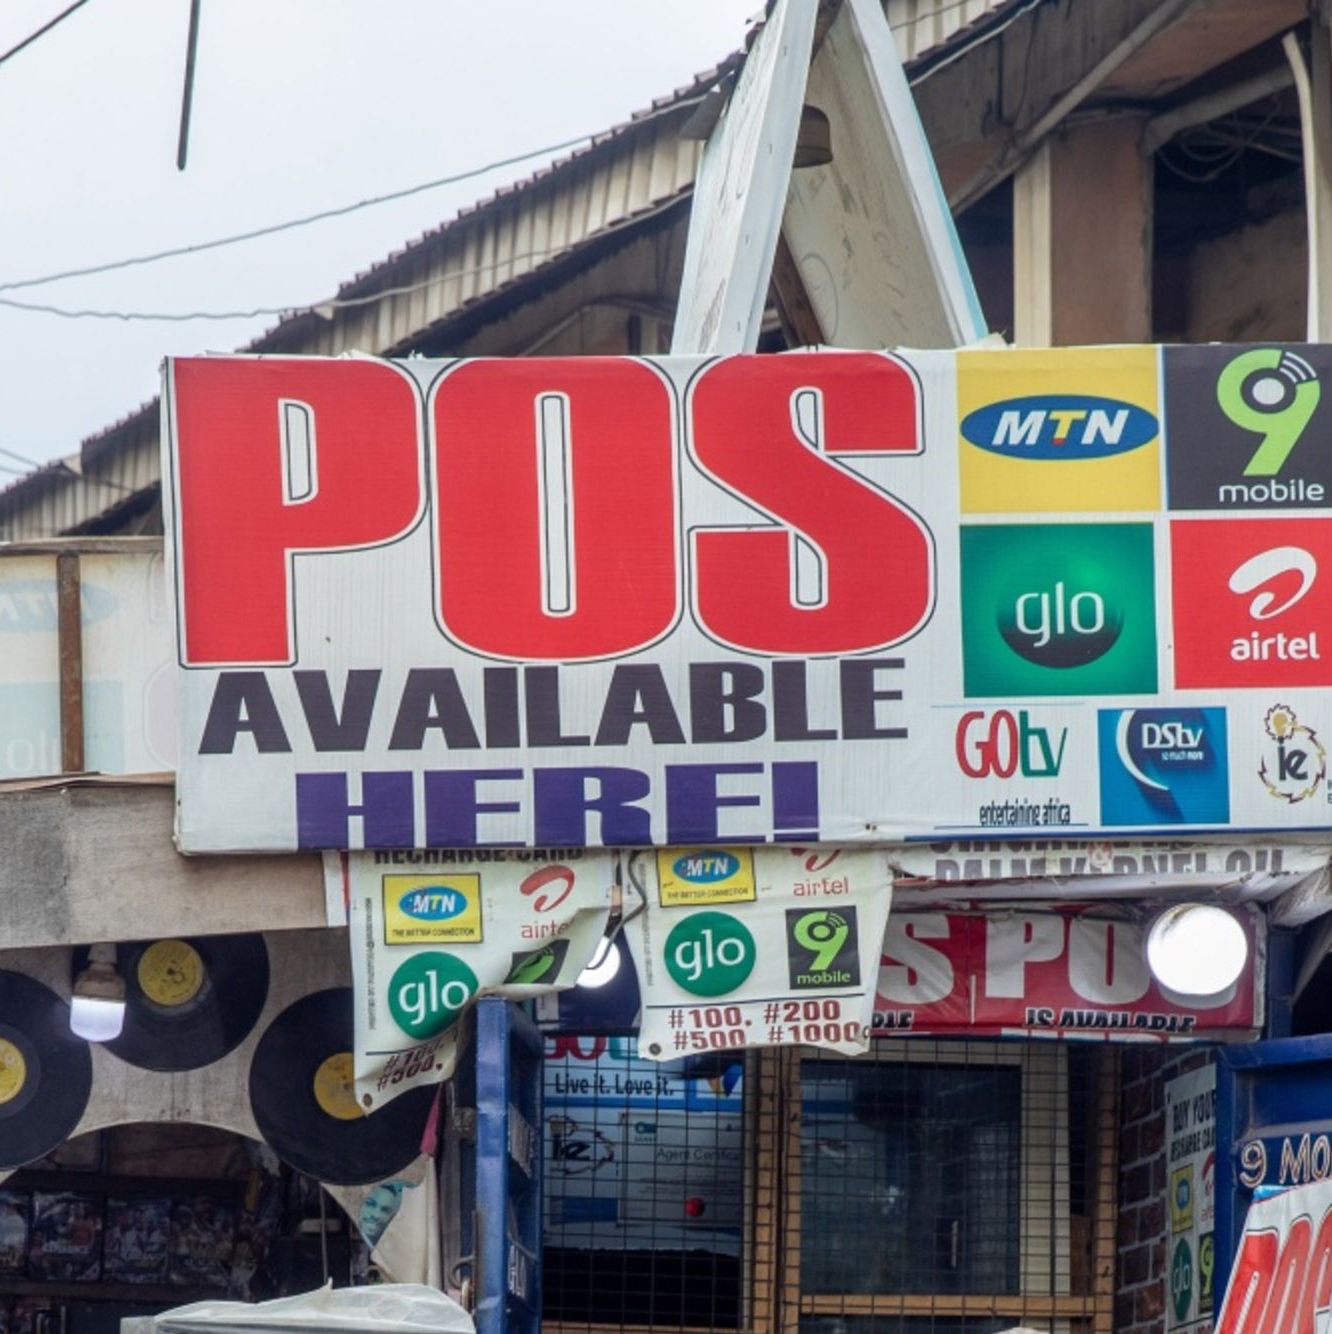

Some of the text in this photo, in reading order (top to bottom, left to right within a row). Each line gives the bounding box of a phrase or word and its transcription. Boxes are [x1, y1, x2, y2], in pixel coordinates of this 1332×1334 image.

[992, 408, 1129, 446] MTN
[1217, 349, 1322, 477] 9
[173, 352, 937, 667] POS
[1219, 478, 1325, 503] mobile
[1014, 581, 1106, 647] glo
[1229, 631, 1321, 661] airtel
[198, 658, 908, 755] AVAILABLE
[955, 709, 1068, 778] GOtv
[296, 761, 820, 849] HERE!
[979, 797, 1071, 828] entertaining africa
[686, 857, 729, 877] MTN
[793, 877, 850, 897] airtel
[413, 894, 456, 913] MTN
[674, 929, 746, 981] glo
[794, 911, 849, 971] 9
[398, 970, 470, 1025] glo
[797, 970, 852, 985] mobile
[668, 999, 841, 1029] #100. #200
[555, 1073, 589, 1095] Live
[615, 1074, 654, 1096] Love
[1239, 1139, 1267, 1188] 9
